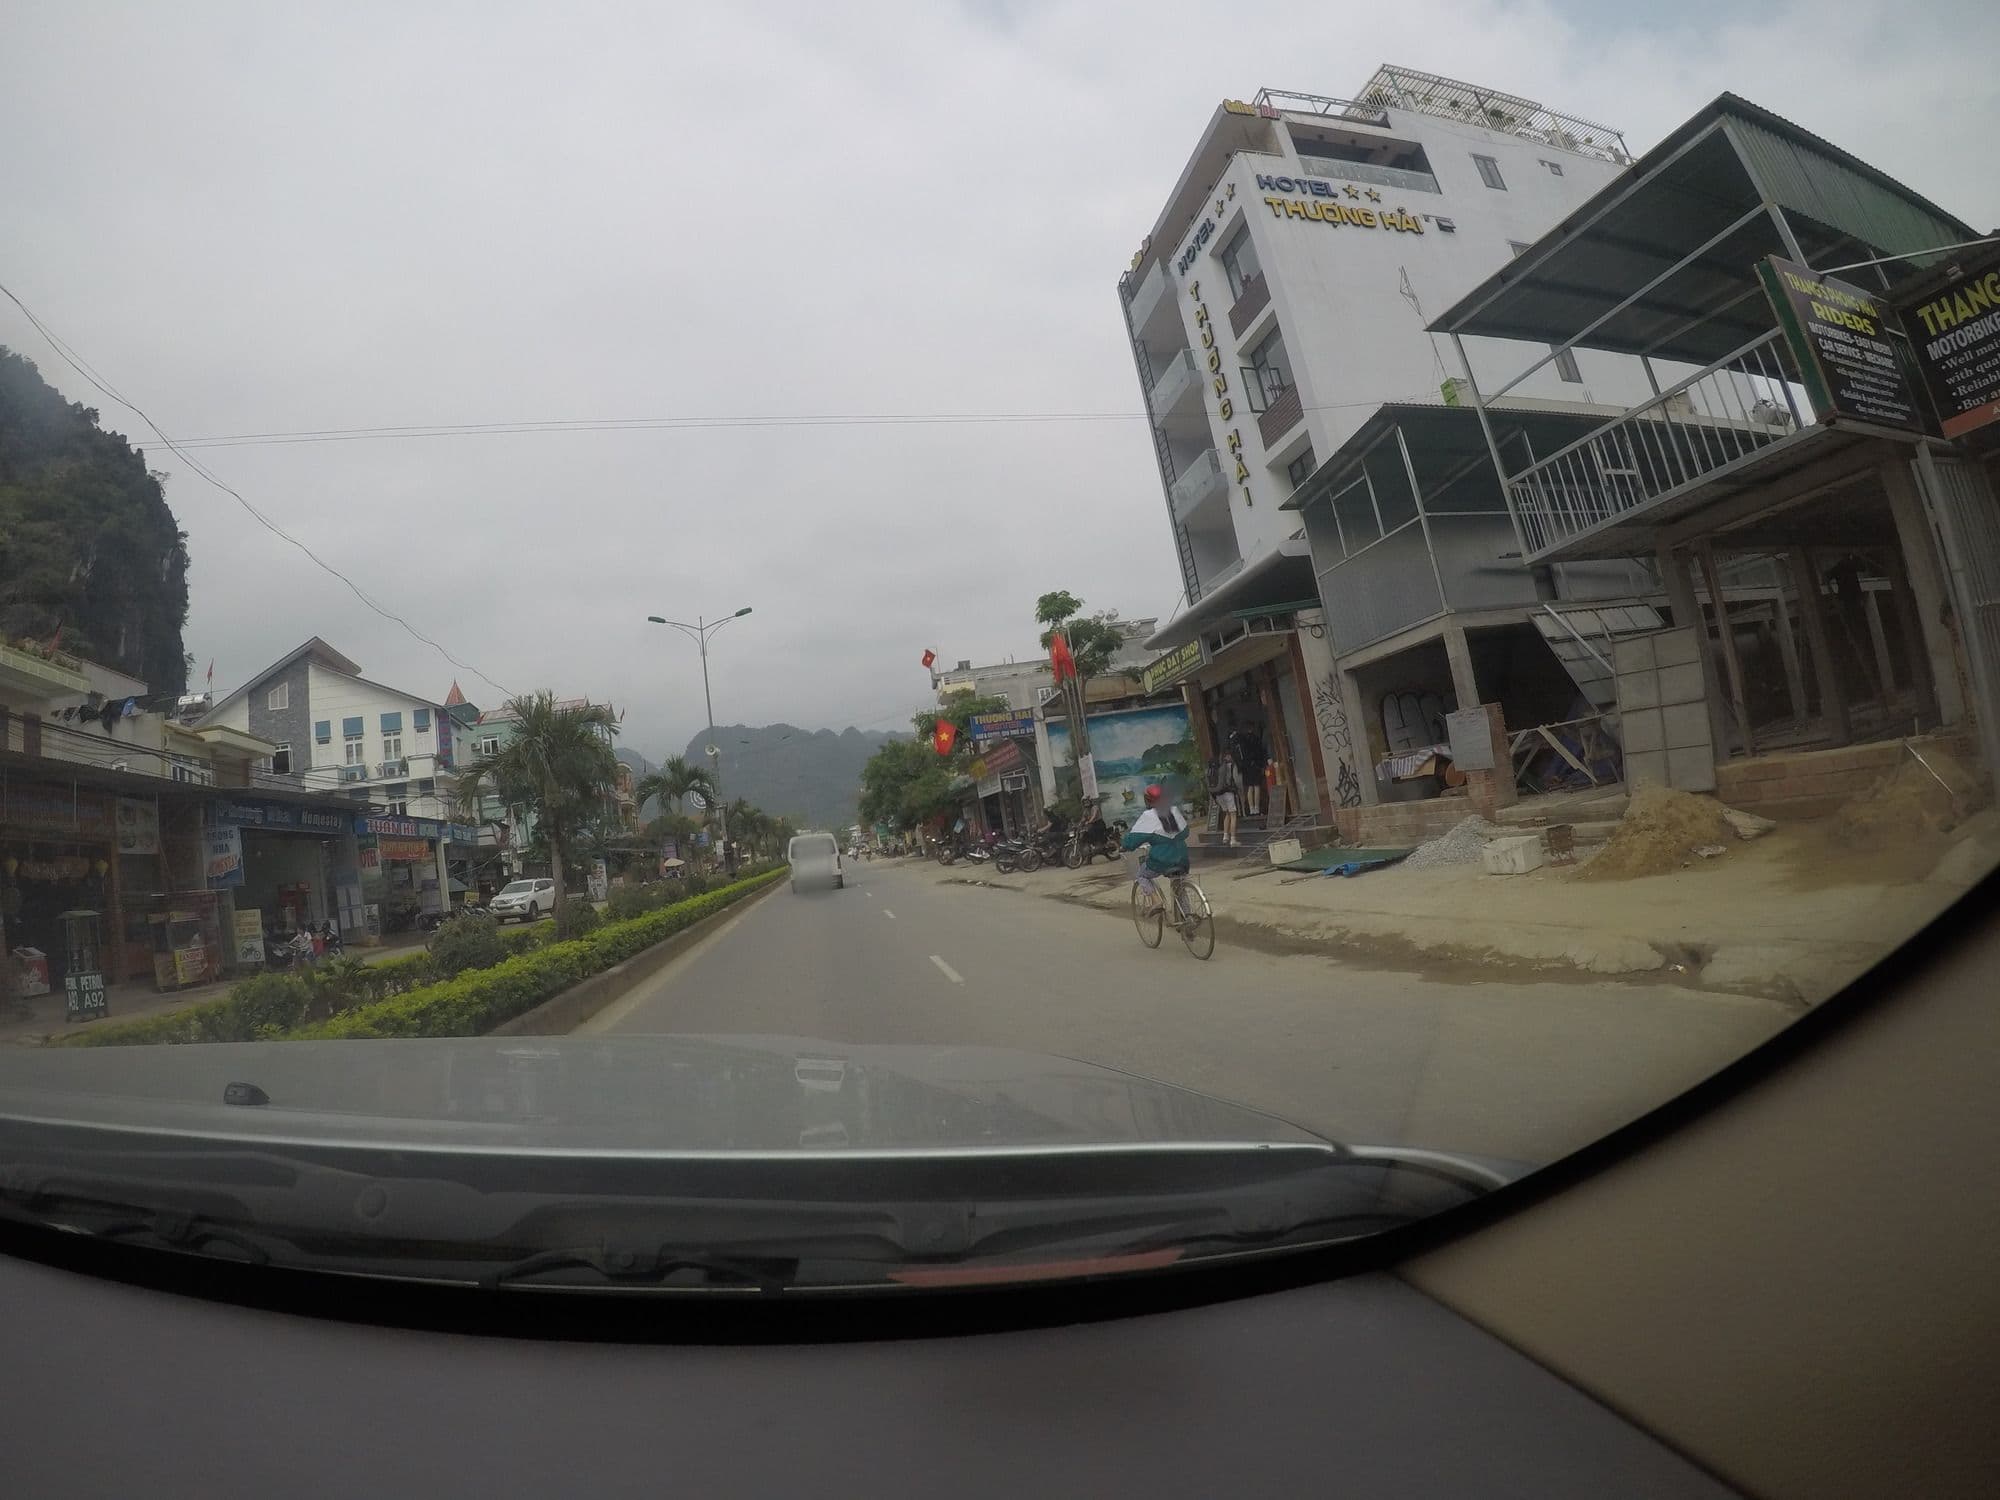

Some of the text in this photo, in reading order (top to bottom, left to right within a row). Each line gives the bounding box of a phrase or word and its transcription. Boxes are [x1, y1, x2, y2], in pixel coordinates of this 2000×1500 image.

[1256, 173, 1339, 198] HOTEL
[1178, 217, 1215, 276] HOTEL
[1811, 301, 1876, 336] RIDERS
[1976, 339, 2000, 357] mai
[1181, 640, 1199, 661] SHOP
[301, 807, 343, 829] Homestay
[80, 974, 104, 991] PETROL
[85, 991, 105, 1008] A92
